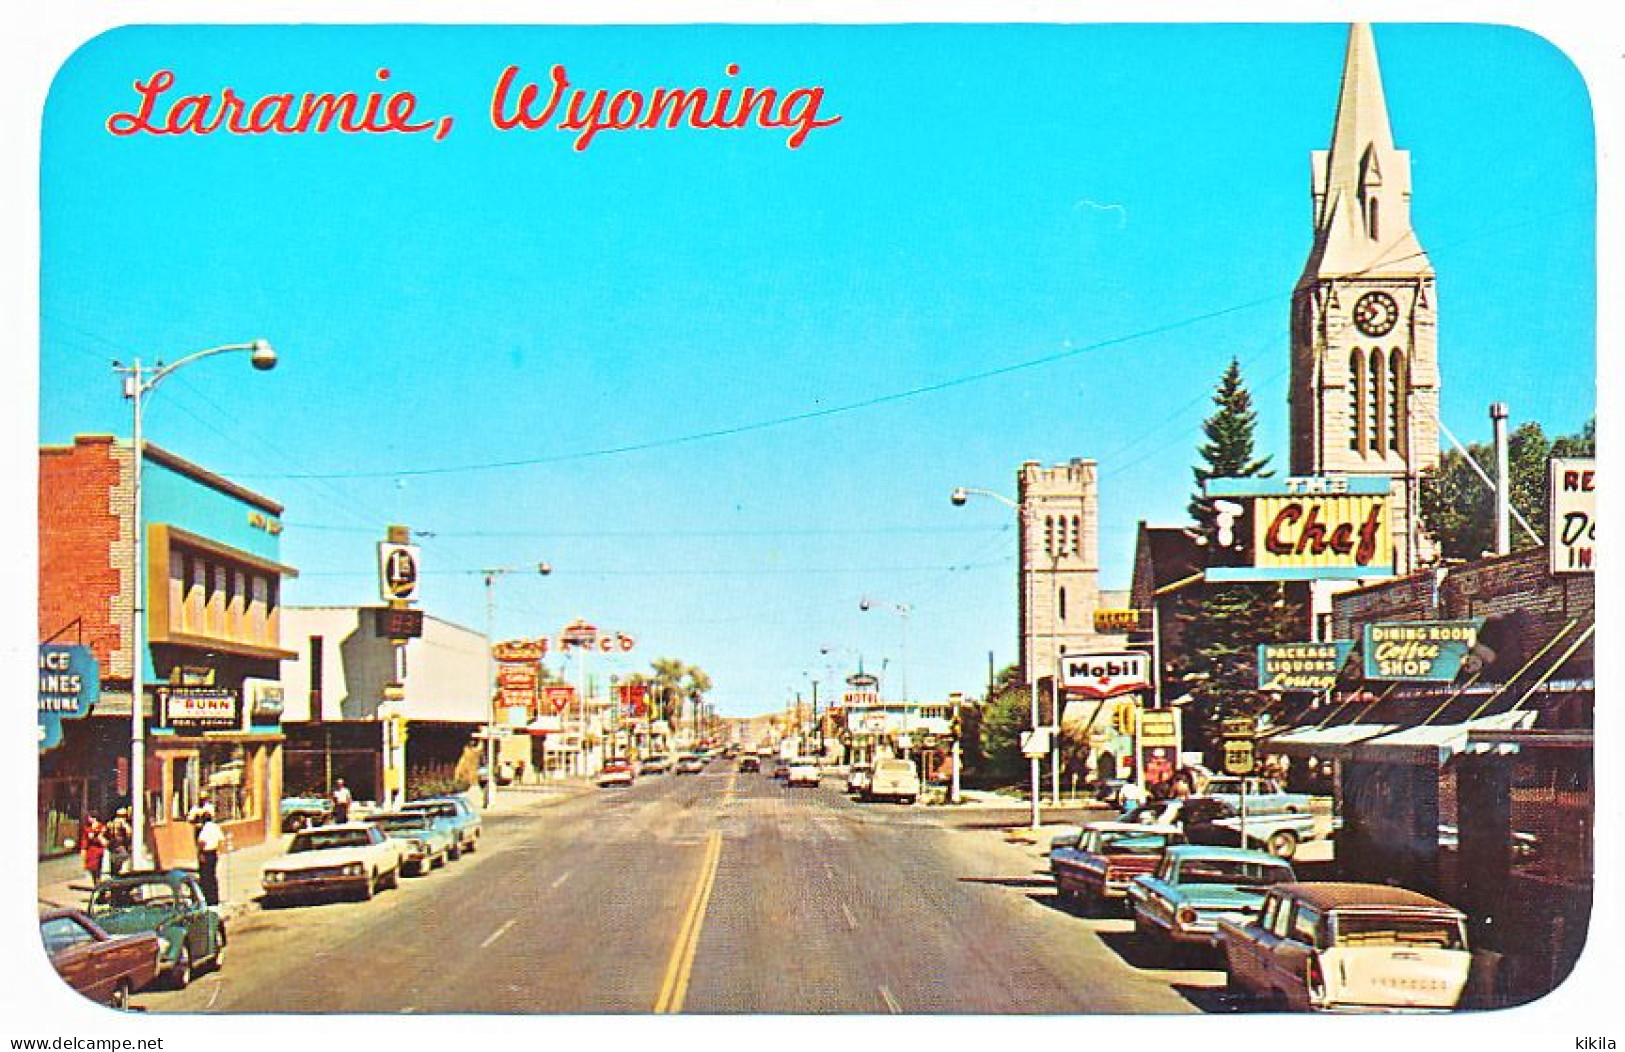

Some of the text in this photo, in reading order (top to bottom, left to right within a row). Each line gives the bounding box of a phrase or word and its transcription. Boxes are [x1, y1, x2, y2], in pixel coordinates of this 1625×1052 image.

[1285, 477, 1346, 495] THE
[1266, 503, 1382, 565] Chef
[1372, 626, 1476, 643] DINING ROOM
[1266, 645, 1337, 659] PACKAGE
[1374, 642, 1440, 661] Coffee
[1069, 659, 1139, 678] Mobil
[1266, 659, 1336, 674] LIQUORS
[1380, 660, 1432, 676] SHOP
